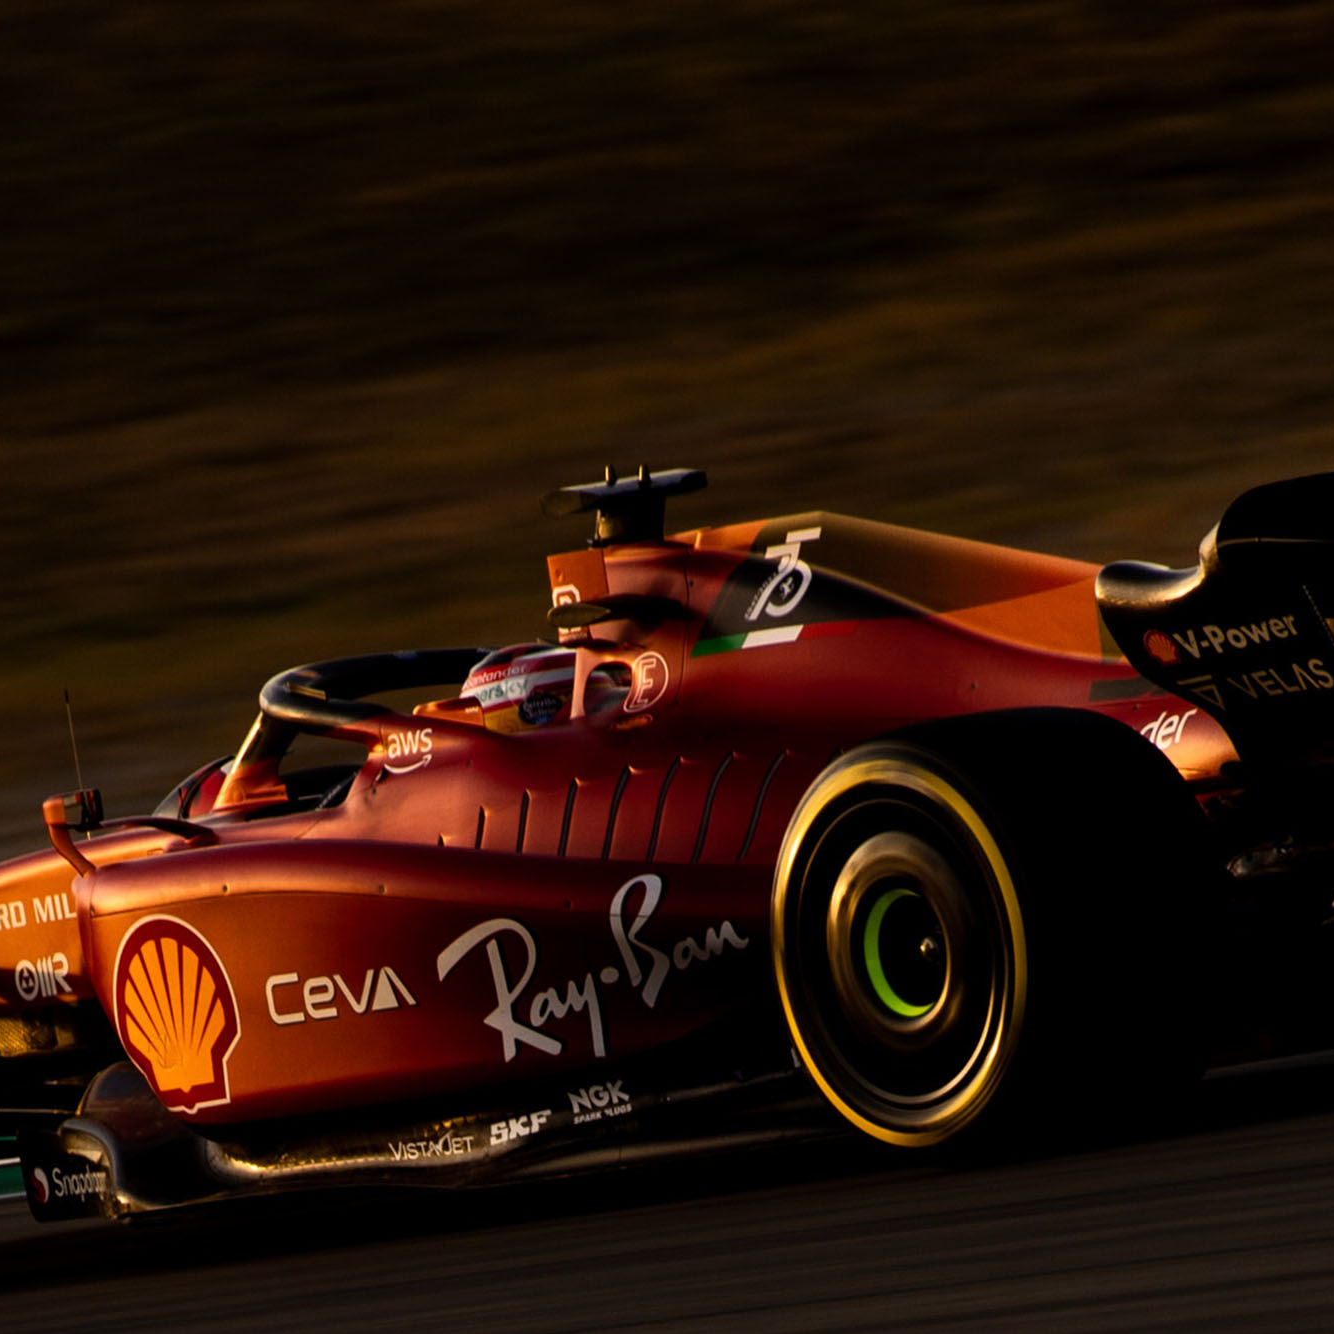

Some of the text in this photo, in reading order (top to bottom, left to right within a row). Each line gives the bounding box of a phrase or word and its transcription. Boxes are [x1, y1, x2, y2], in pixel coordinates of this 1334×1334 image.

[1172, 614, 1298, 660] V-Power
[1226, 657, 1334, 699] VELAS
[387, 727, 433, 759] aws
[32, 892, 78, 925] MIL
[566, 1079, 630, 1115] NGK
[489, 1108, 553, 1146] SKF
